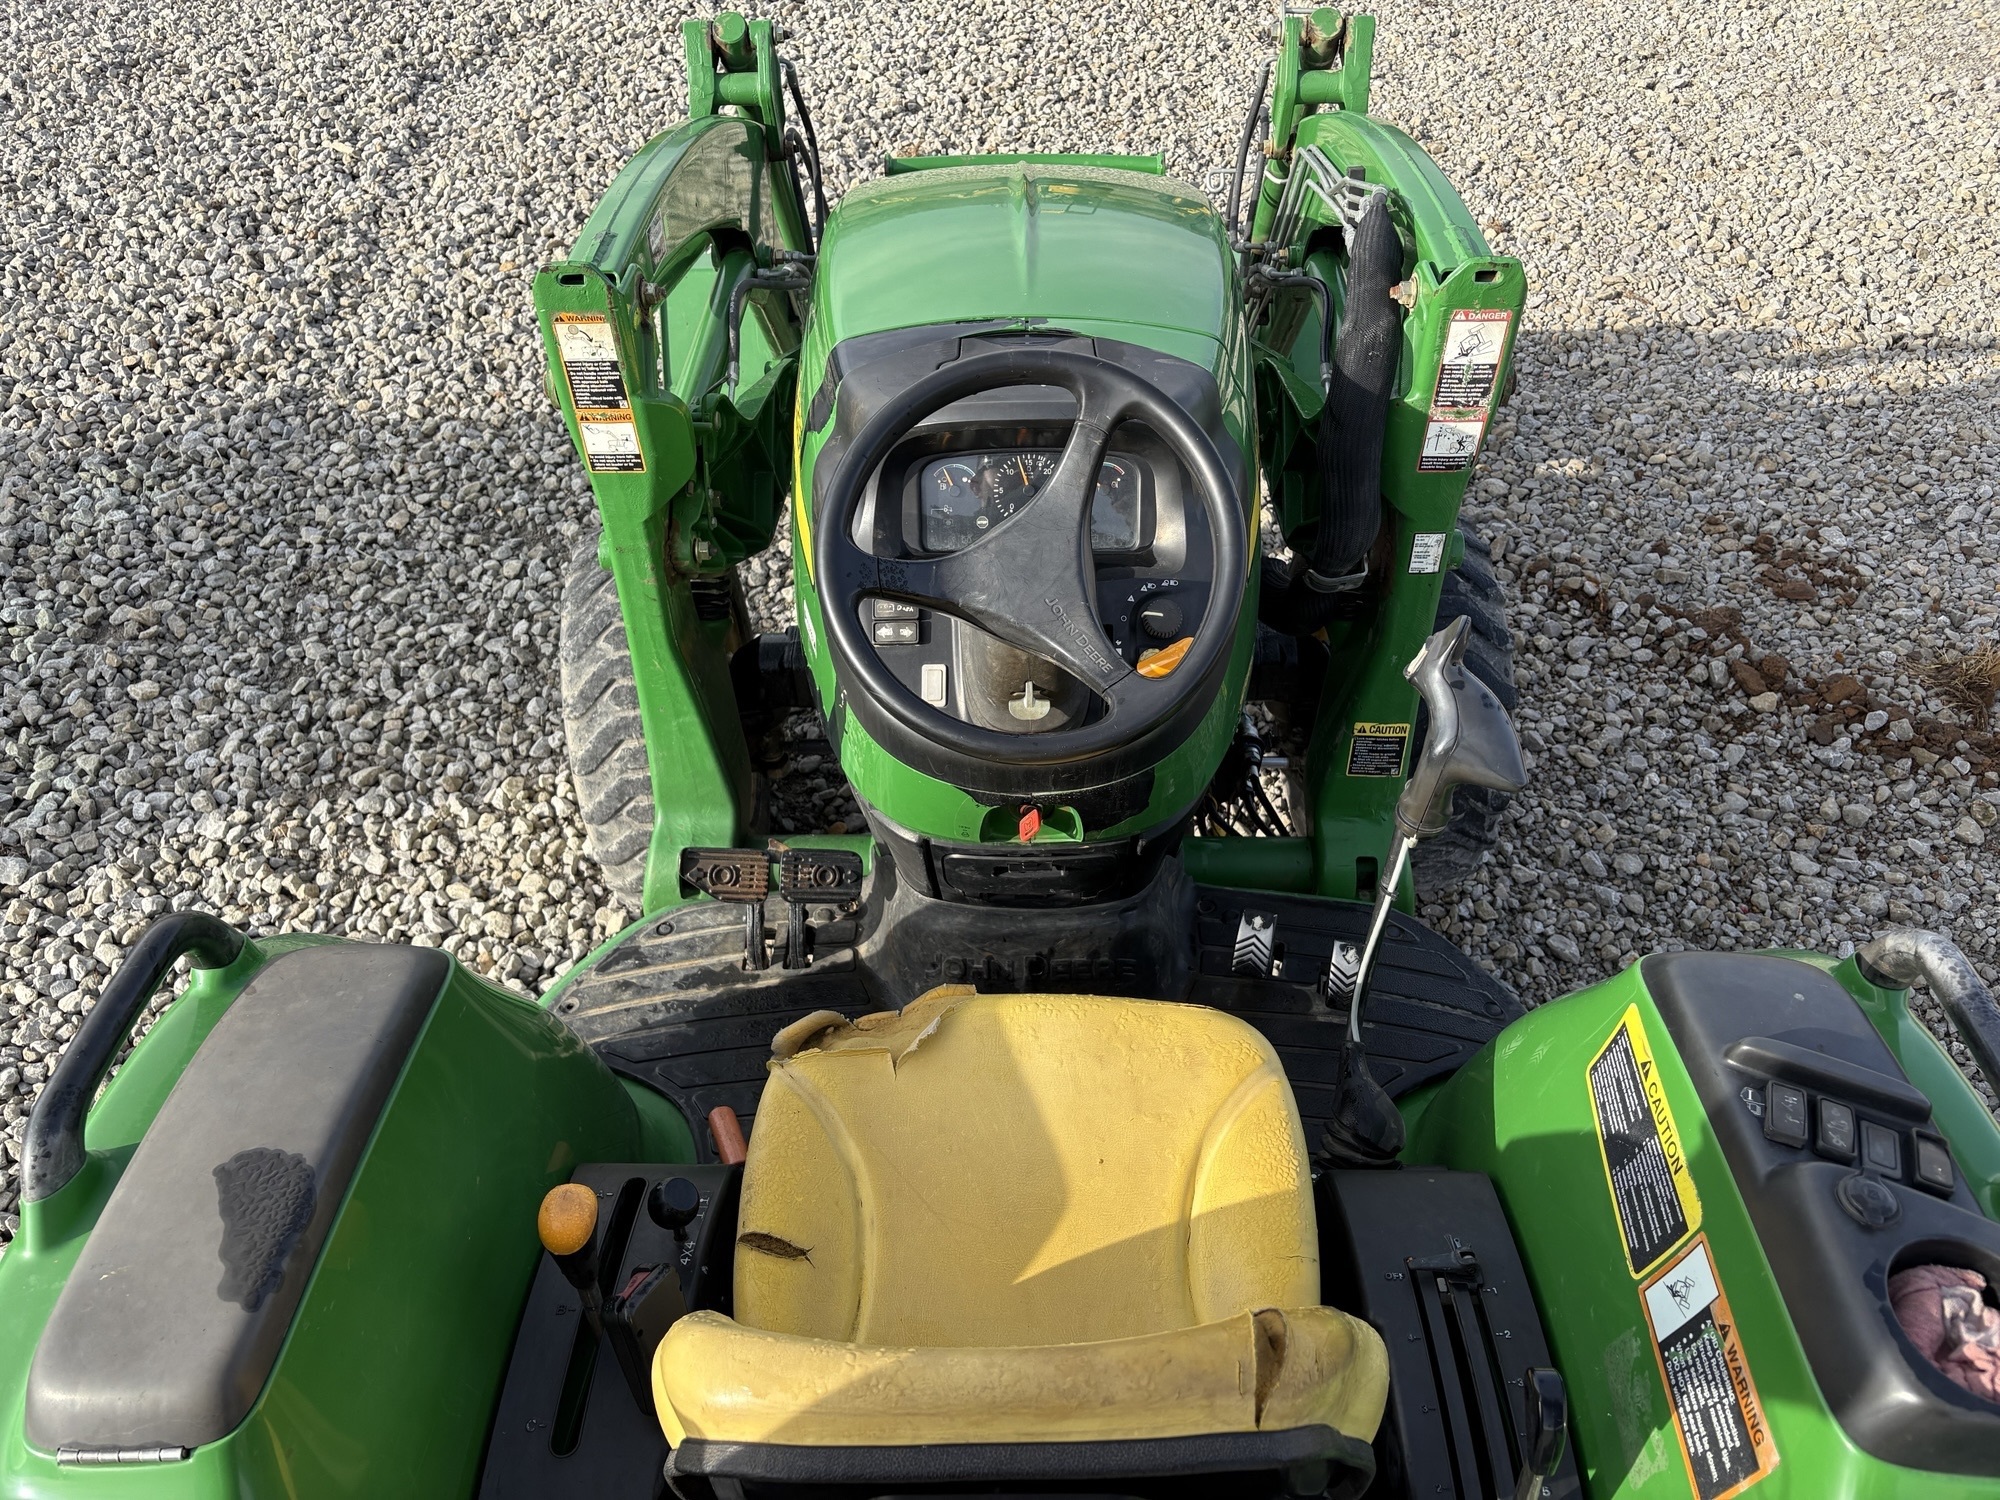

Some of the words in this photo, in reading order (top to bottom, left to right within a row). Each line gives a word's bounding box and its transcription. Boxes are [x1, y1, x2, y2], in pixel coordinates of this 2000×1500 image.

[1468, 312, 1508, 320] DANGER
[1044, 598, 1079, 637] JOHN
[1075, 634, 1114, 674] DEERE
[1369, 724, 1408, 735] CAUTION
[924, 953, 1015, 981] JOHN
[1023, 955, 1137, 981] DEERE
[1648, 1081, 1683, 1176] CAUTION
[680, 1240, 696, 1266] 4X4
[1504, 1329, 1512, 1338] 2
[1671, 1355, 1680, 1372] DO
[1694, 1356, 1703, 1373] not
[1705, 1318, 1718, 1349] AOID
[1714, 1349, 1736, 1405] CRUSHING:
[1516, 1377, 1524, 1387] 3
[1675, 1371, 1686, 1394] NOT
[1689, 1365, 1700, 1387] seat
[1695, 1386, 1706, 1408] belt.
[1698, 1372, 1710, 1399] jump
[1701, 1332, 1714, 1358] Keep
[1708, 1357, 1726, 1397] Rollover
[1721, 1397, 1741, 1447] Protective
[1682, 1393, 1691, 1412] use
[1706, 1398, 1713, 1407] if
[1725, 1342, 1766, 1447] WARNING
[1421, 1405, 1429, 1413] 3
[1665, 1360, 1676, 1385] Drive
[1672, 1385, 1682, 1406] with
[1678, 1405, 1689, 1431] extra
[1685, 1431, 1696, 1456] care.
[1682, 1368, 1699, 1411] structure
[1694, 1410, 1706, 1436] must
[1701, 1436, 1710, 1451] be
[1708, 1380, 1719, 1403] fully
[1715, 1402, 1734, 1451] extended.
[1687, 1411, 1697, 1434] seat
[1708, 1406, 1725, 1449] machine
[1693, 1433, 1704, 1456] belt.
[1721, 1448, 1733, 1472] tips.
[1541, 1486, 1551, 1497] 5
